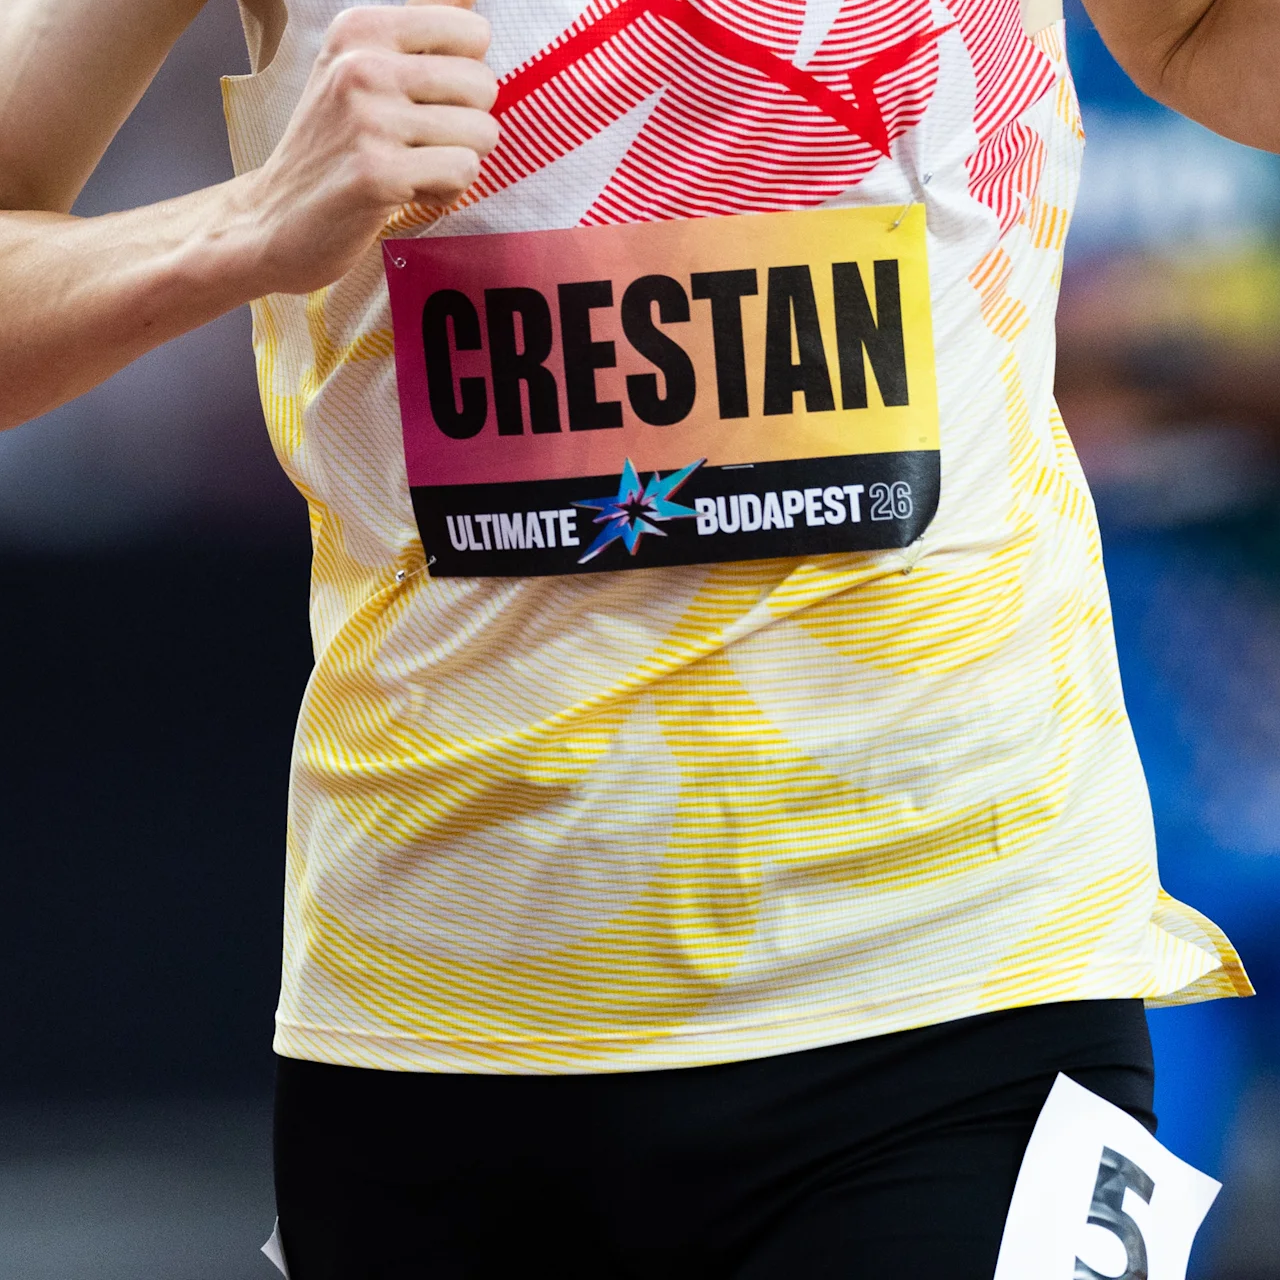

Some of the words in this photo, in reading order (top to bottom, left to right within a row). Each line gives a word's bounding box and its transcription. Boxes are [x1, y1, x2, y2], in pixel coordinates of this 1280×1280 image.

[421, 258, 909, 439] CRESTAN
[446, 508, 580, 552] ULTIMATE
[695, 484, 865, 536] BUDAPEST
[870, 481, 913, 521] 26
[1072, 1145, 1155, 1280] 5
